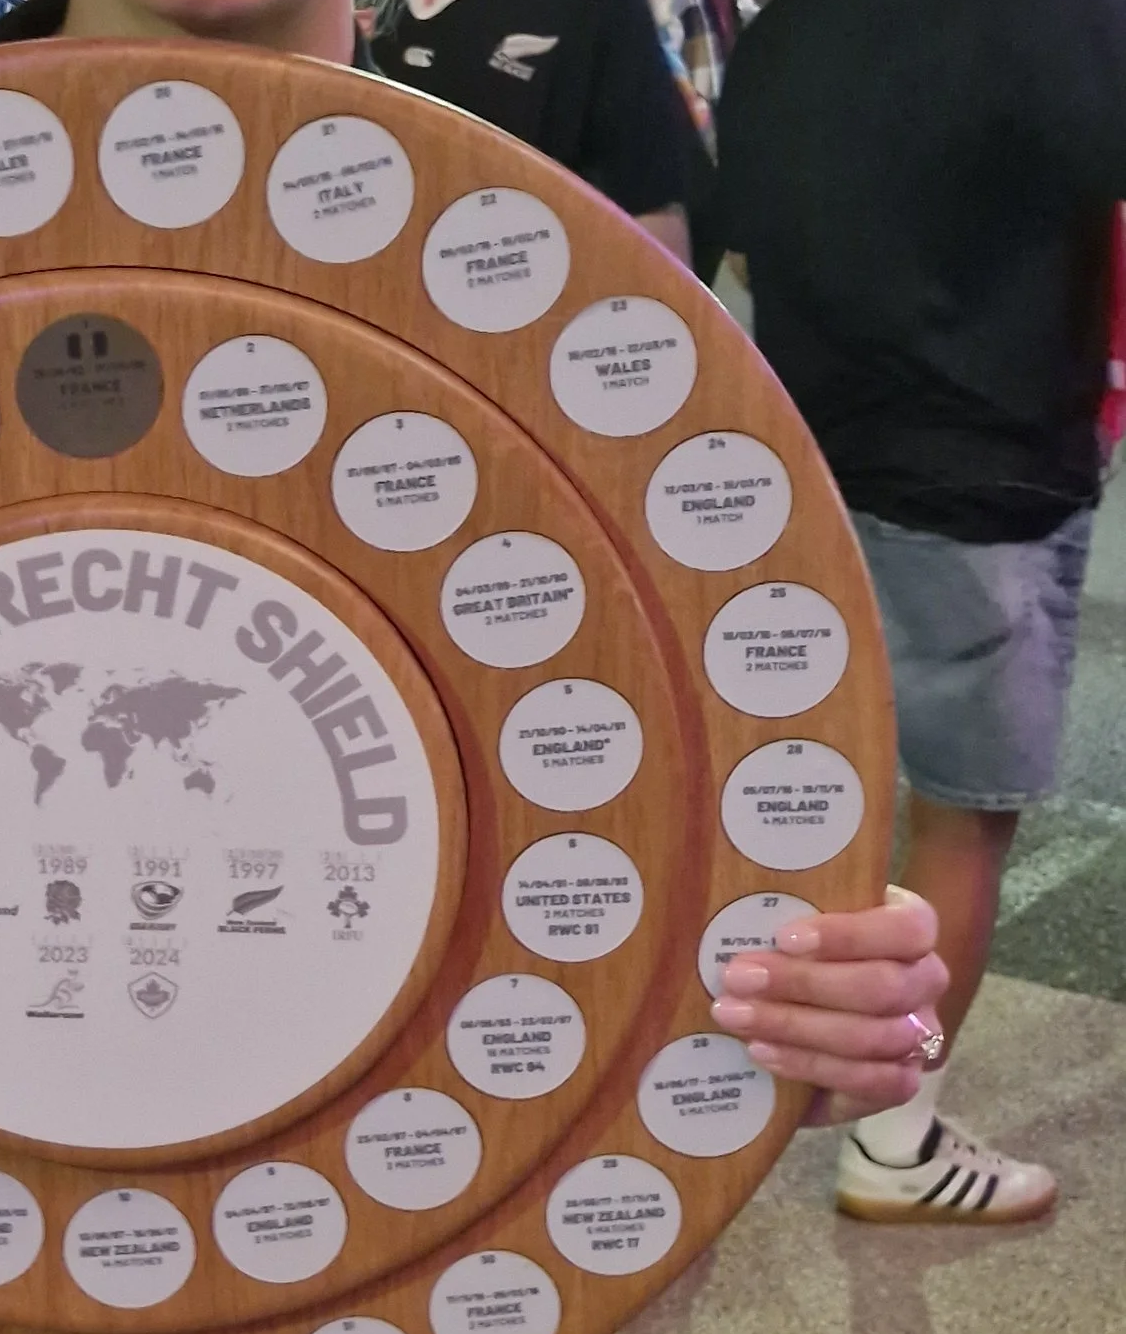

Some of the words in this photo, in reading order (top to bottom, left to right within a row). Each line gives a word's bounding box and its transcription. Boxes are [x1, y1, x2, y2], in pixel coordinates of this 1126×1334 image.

[140, 145, 203, 167] FRANCE
[318, 181, 364, 204] ITALY
[466, 250, 529, 274] FRANCE
[476, 267, 532, 285] MATCHES
[246, 342, 255, 353] 2
[594, 358, 652, 376] WALES
[609, 376, 650, 389] MATCH
[199, 397, 311, 420] NETHERLANDS
[375, 475, 436, 493] FRANCE
[681, 495, 756, 513] ENGLAND
[702, 512, 744, 524] MATCH
[502, 538, 512, 549] 4
[452, 598, 503, 616] GREAT
[494, 608, 548, 624] MATCHES
[746, 644, 808, 659] FRANCE
[754, 660, 809, 672] MATCHES
[234, 599, 409, 846] SHIELD
[550, 755, 605, 768] MATCHES
[756, 799, 829, 813] ENGLAND
[771, 814, 826, 826] MATCHES
[38, 857, 88, 874] 1989
[132, 860, 183, 877] 1991
[229, 862, 279, 879] 1997
[324, 865, 376, 882] 2013
[516, 893, 570, 907] UNITED
[571, 892, 632, 906] STATES
[762, 897, 779, 908] 27
[552, 907, 606, 919] MATCHES
[548, 924, 583, 937] RWC
[38, 946, 89, 964] 2023
[129, 948, 181, 966] 2024
[509, 978, 519, 988] 7
[482, 1030, 553, 1046] ENGLAND
[499, 1045, 551, 1057] MATCHES
[490, 1062, 525, 1075] RWC
[672, 1087, 742, 1106] ENGLAND
[686, 1102, 740, 1116] MATCHES
[384, 1142, 442, 1159] FRANCE
[394, 1157, 446, 1170] MATCHES
[246, 1214, 313, 1233] ENGLAND
[562, 1212, 595, 1226] NEW
[597, 1207, 666, 1222] ZEALAND
[79, 1245, 111, 1258] NEW
[113, 1241, 182, 1256] ZEALAND
[591, 1238, 625, 1251] RWC
[626, 1237, 640, 1248] 17
[466, 1301, 523, 1318] FRANCE
